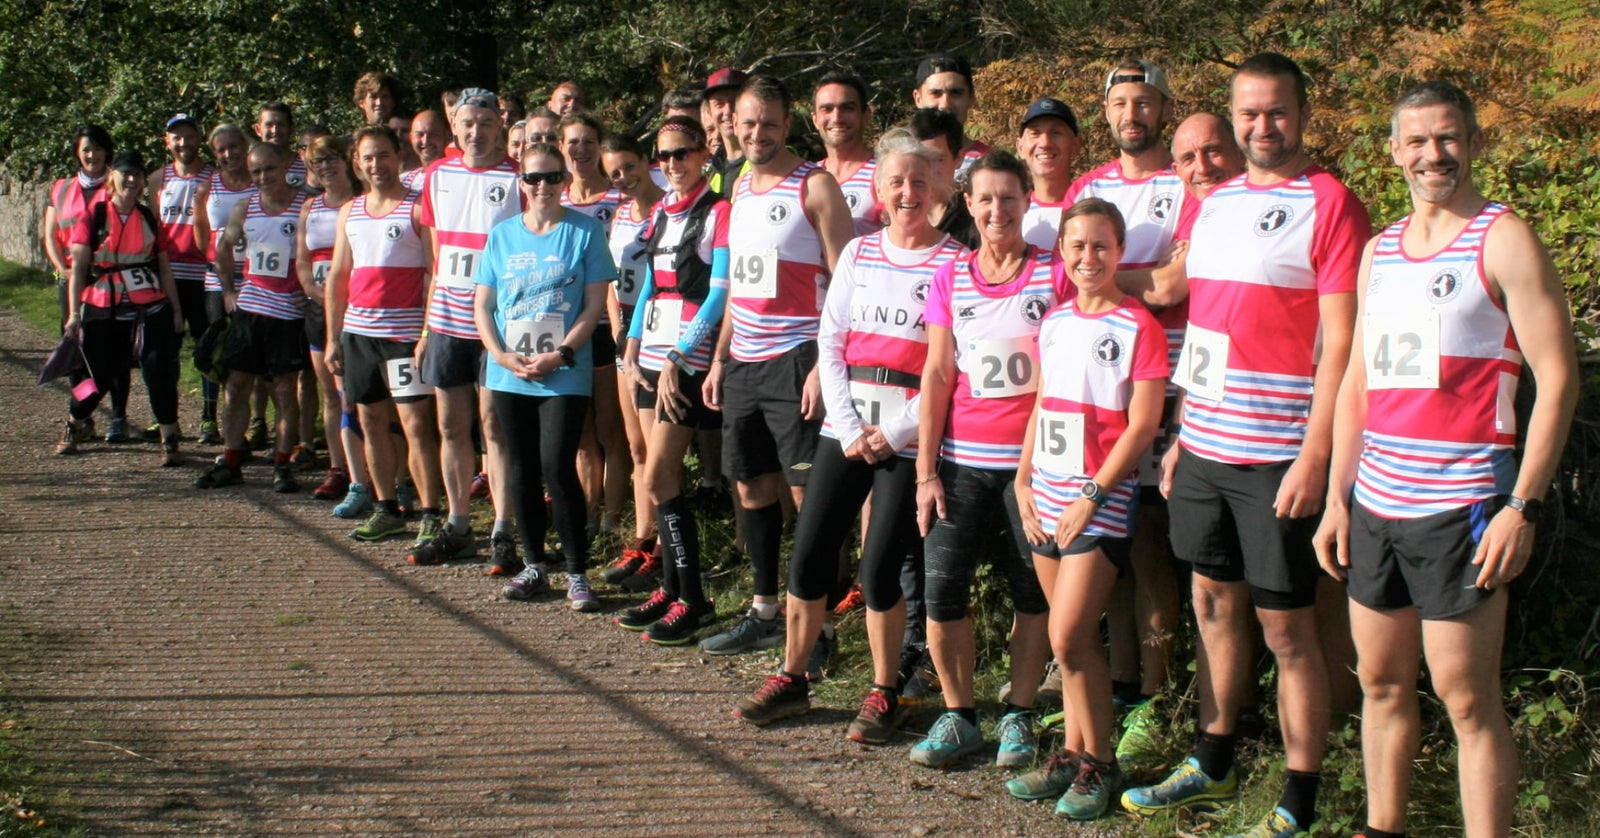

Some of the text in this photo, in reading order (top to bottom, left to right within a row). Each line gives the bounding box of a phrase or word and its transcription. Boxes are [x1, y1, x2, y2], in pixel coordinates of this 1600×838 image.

[256, 251, 280, 271] 16
[315, 265, 331, 284] 4
[449, 252, 474, 277] 11
[528, 270, 543, 286] ON
[546, 263, 565, 279] AIR
[733, 255, 765, 284] 49
[505, 291, 564, 319] WORCESTER
[514, 332, 555, 358] 46
[1373, 332, 1422, 376] 42
[398, 363, 425, 386] 5
[981, 352, 1032, 389] 20
[1188, 342, 1211, 387] 12
[1040, 416, 1067, 456] 15
